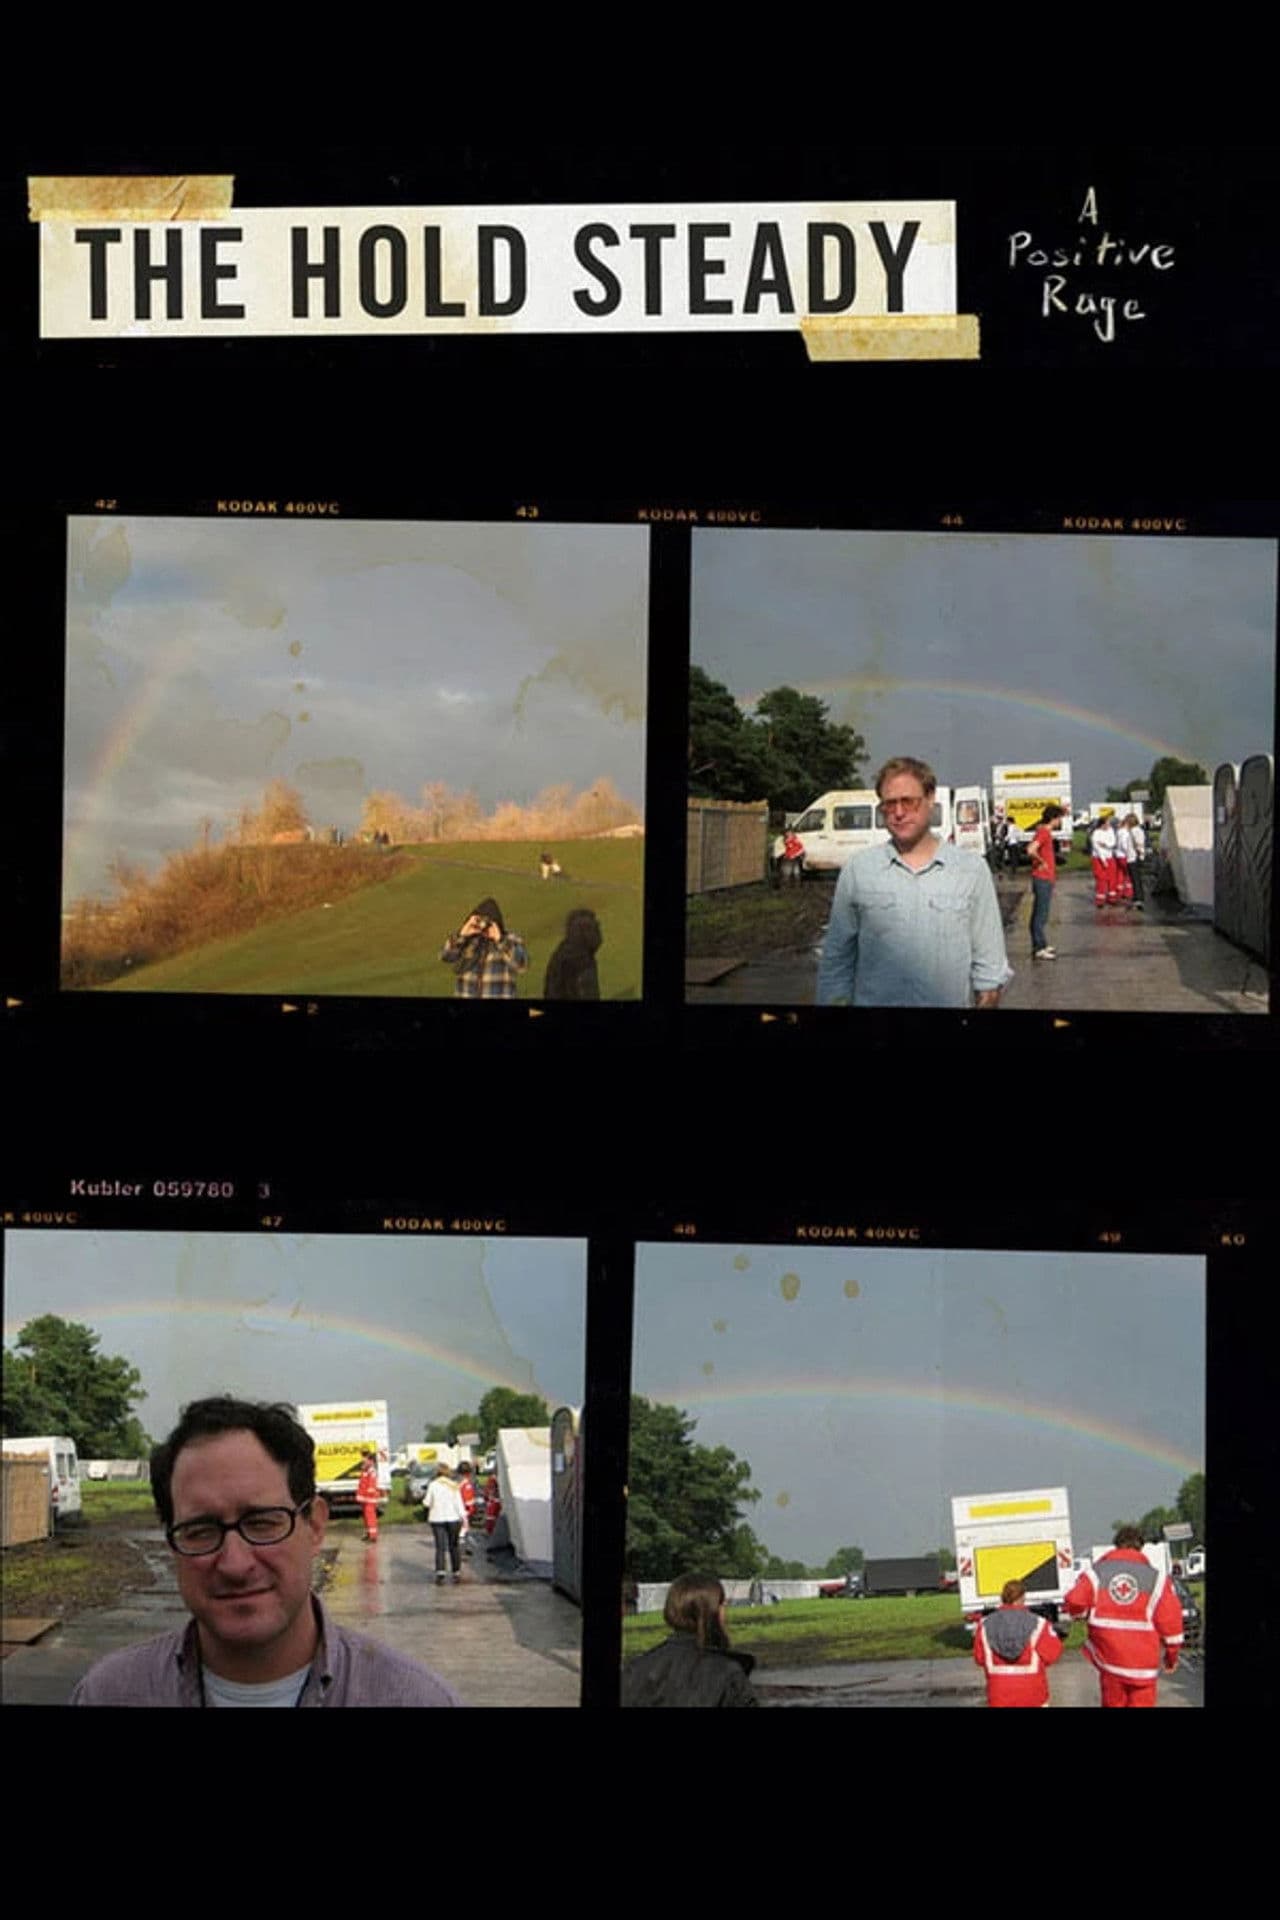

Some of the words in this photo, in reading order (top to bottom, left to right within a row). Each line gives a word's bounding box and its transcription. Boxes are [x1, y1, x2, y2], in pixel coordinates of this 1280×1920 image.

[1077, 186, 1099, 226] A
[1008, 230, 1176, 270] Positive
[75, 227, 246, 321] THE
[291, 224, 528, 319] HOLD
[573, 220, 921, 318] STEADY
[1041, 274, 1147, 343] Rage
[95, 499, 118, 510] 42
[217, 500, 279, 513] KODAK
[284, 502, 340, 515] 400VC
[516, 506, 540, 518] 43
[637, 509, 699, 522] KODAK
[706, 511, 761, 523] 400VC
[941, 515, 964, 526] 44
[1063, 517, 1125, 530] KODAK
[1131, 518, 1188, 531] 400VC
[69, 1178, 142, 1197] Kubler
[152, 1180, 234, 1198] 059780
[22, 1211, 78, 1224] 400VC
[382, 1218, 446, 1230] KODAK
[451, 1219, 507, 1232] 400VC
[796, 1226, 858, 1239] KODAK
[865, 1227, 921, 1240] 400VC
